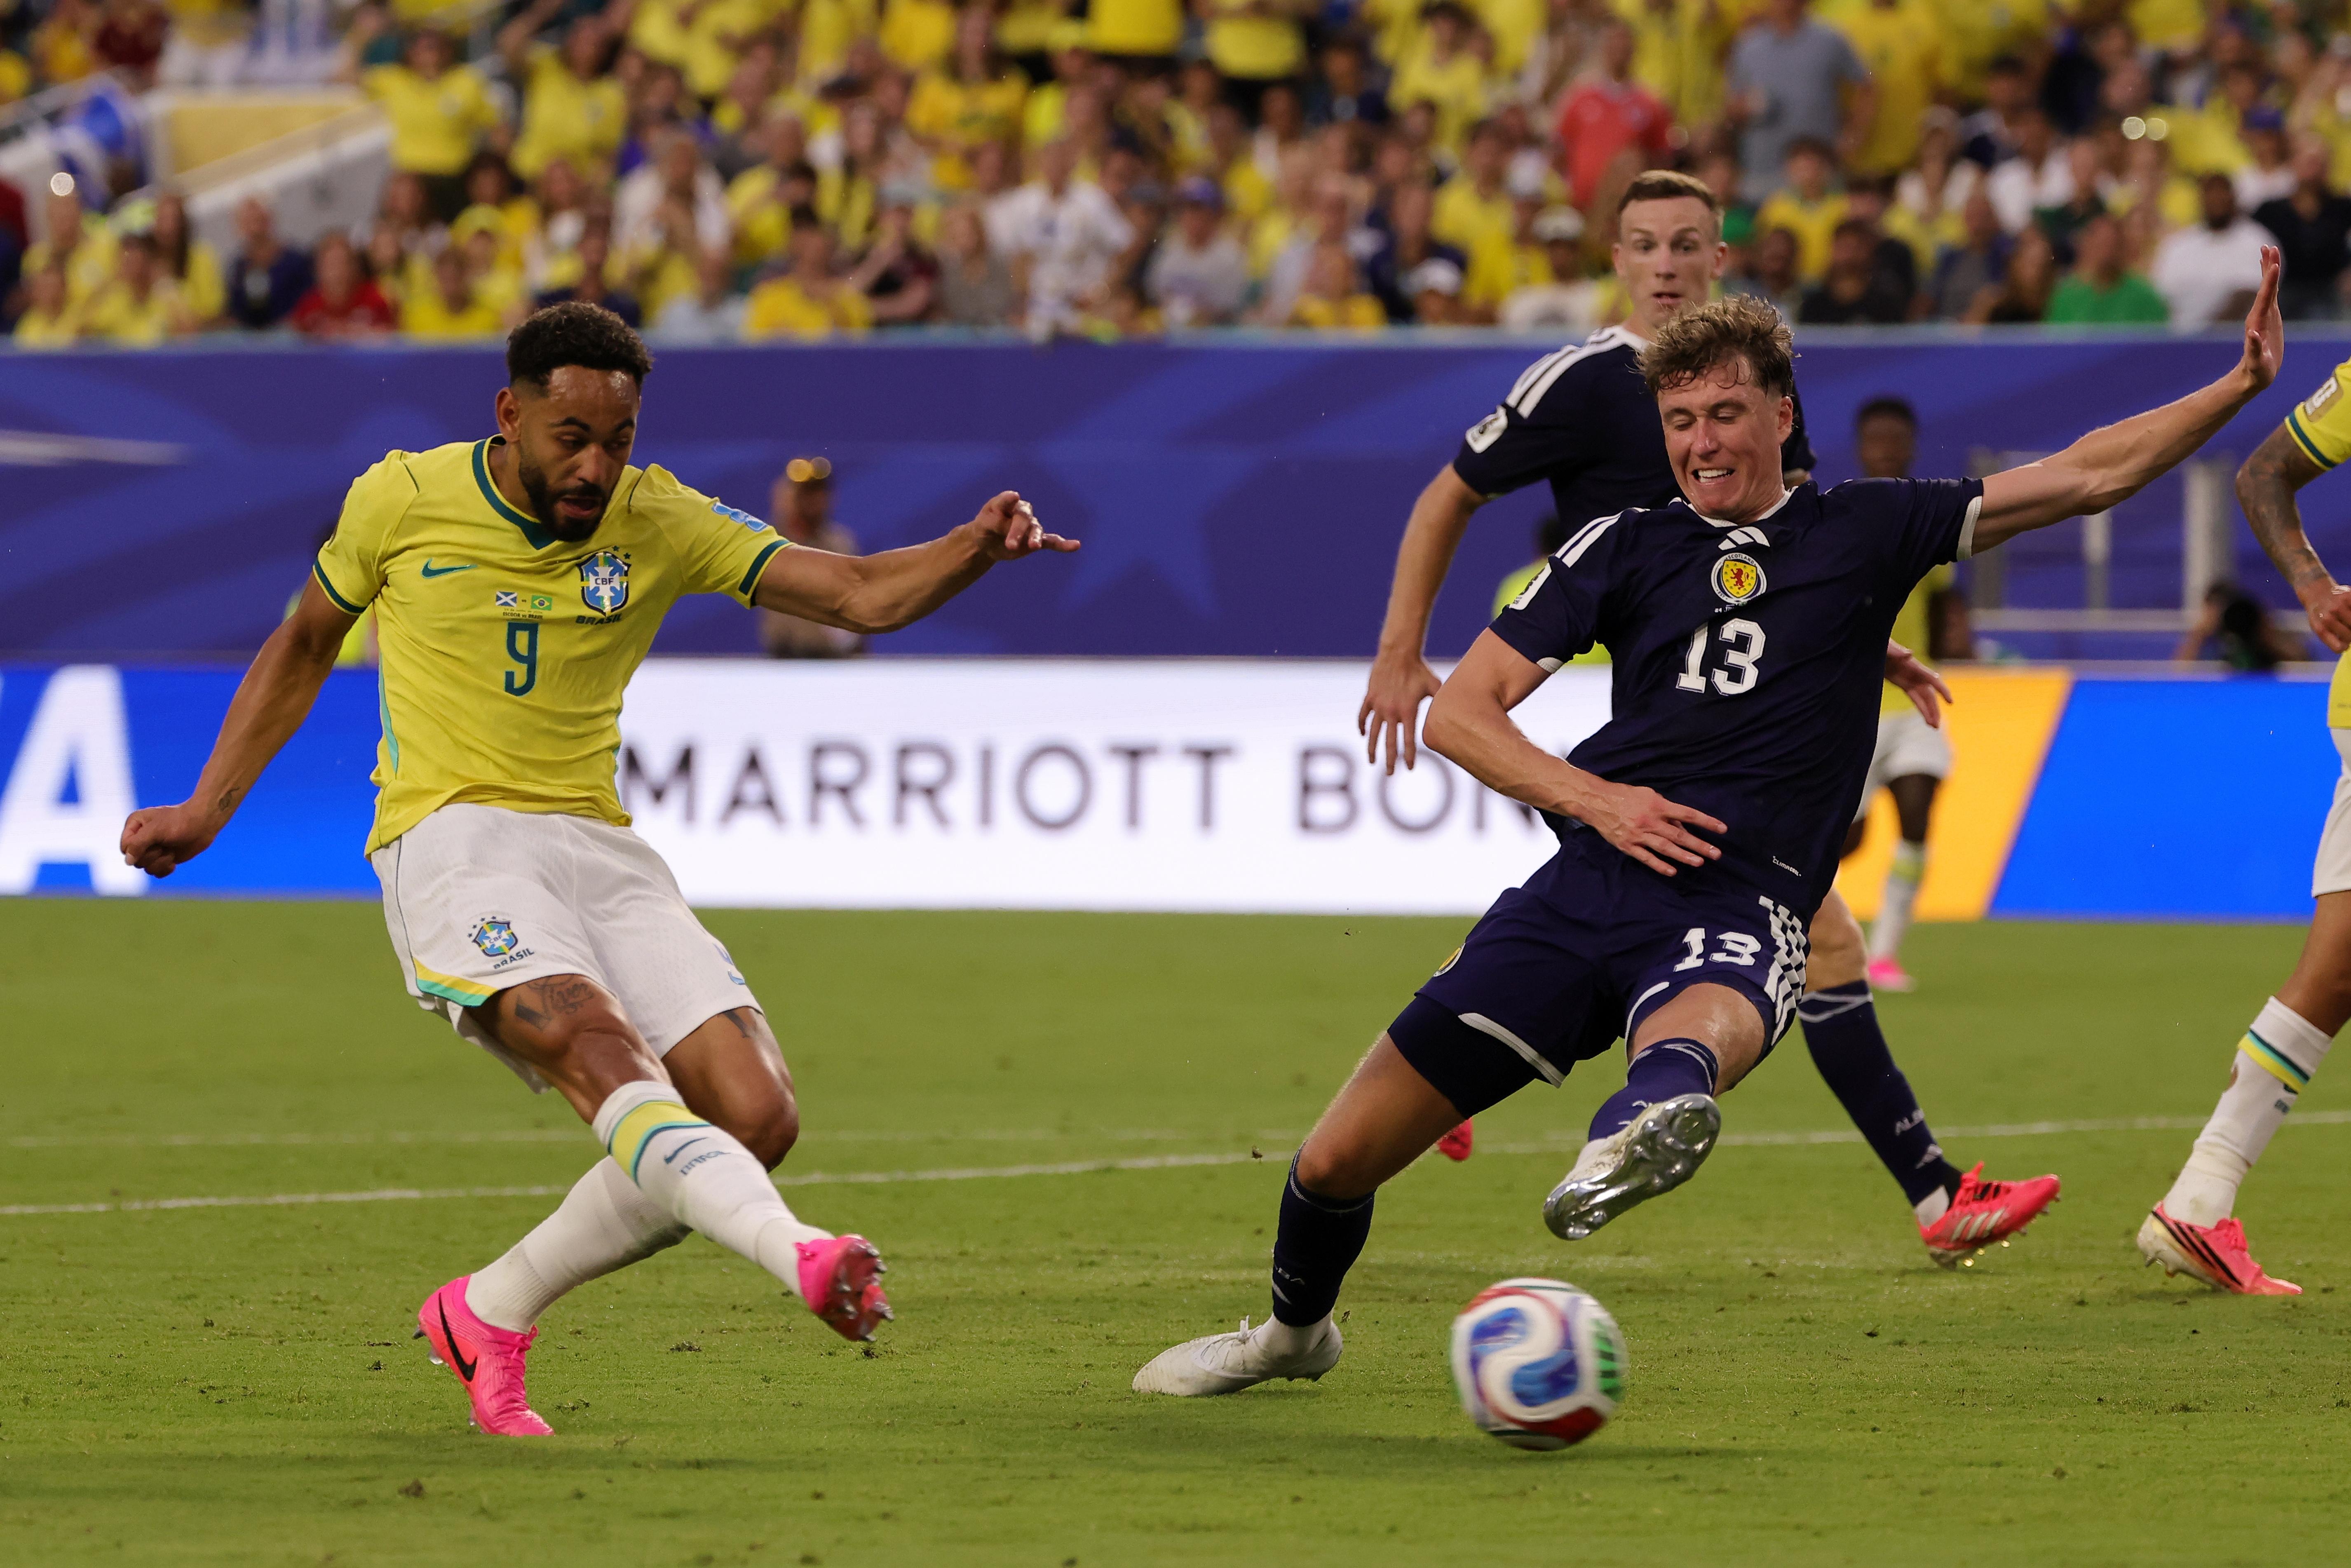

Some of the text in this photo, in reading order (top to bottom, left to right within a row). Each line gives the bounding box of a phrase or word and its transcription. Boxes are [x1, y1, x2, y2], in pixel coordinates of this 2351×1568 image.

[1728, 554, 1755, 564] SCOTLAND
[575, 613, 622, 625] BRASIL
[504, 620, 540, 697] 9
[1675, 618, 1766, 696] 13
[622, 743, 1232, 832] MARRIOTT
[489, 934, 502, 944] CBF
[1673, 927, 1761, 972] 13
[493, 948, 535, 969] BRASIL
